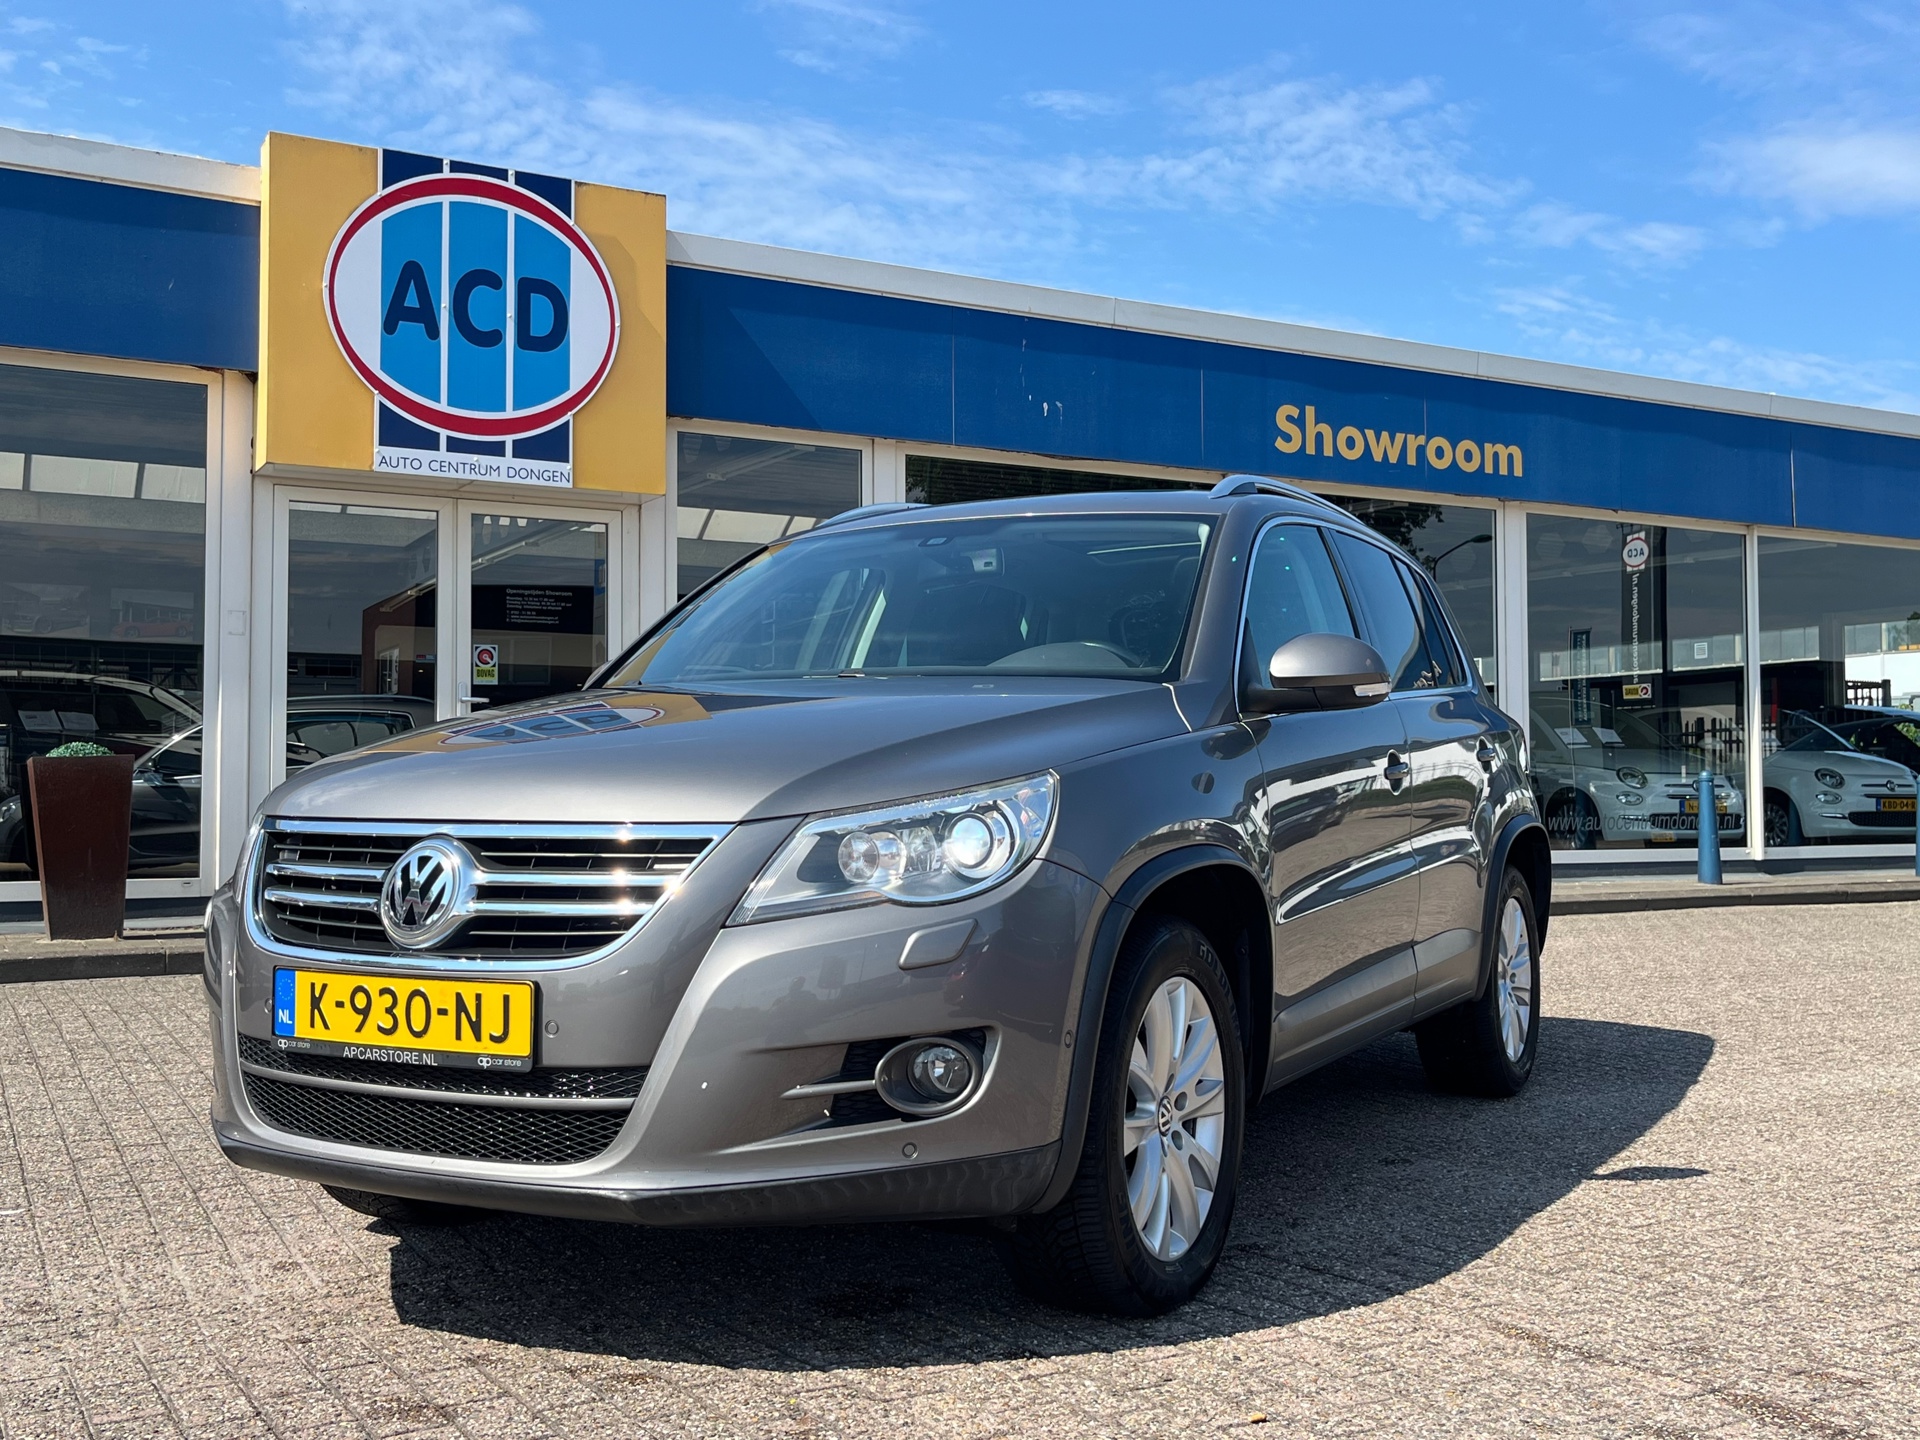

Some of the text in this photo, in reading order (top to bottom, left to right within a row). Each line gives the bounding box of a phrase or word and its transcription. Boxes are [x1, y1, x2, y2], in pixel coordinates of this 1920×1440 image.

[383, 260, 569, 352] ACD
[1274, 404, 1524, 477] Showroom
[377, 455, 571, 484] AUTO CENTRUM DONGEN
[476, 668, 495, 678] BOVAG
[278, 1008, 293, 1024] NL
[309, 981, 511, 1044] K-930-NJ
[343, 1046, 438, 1066] APCARSTORE.NL
